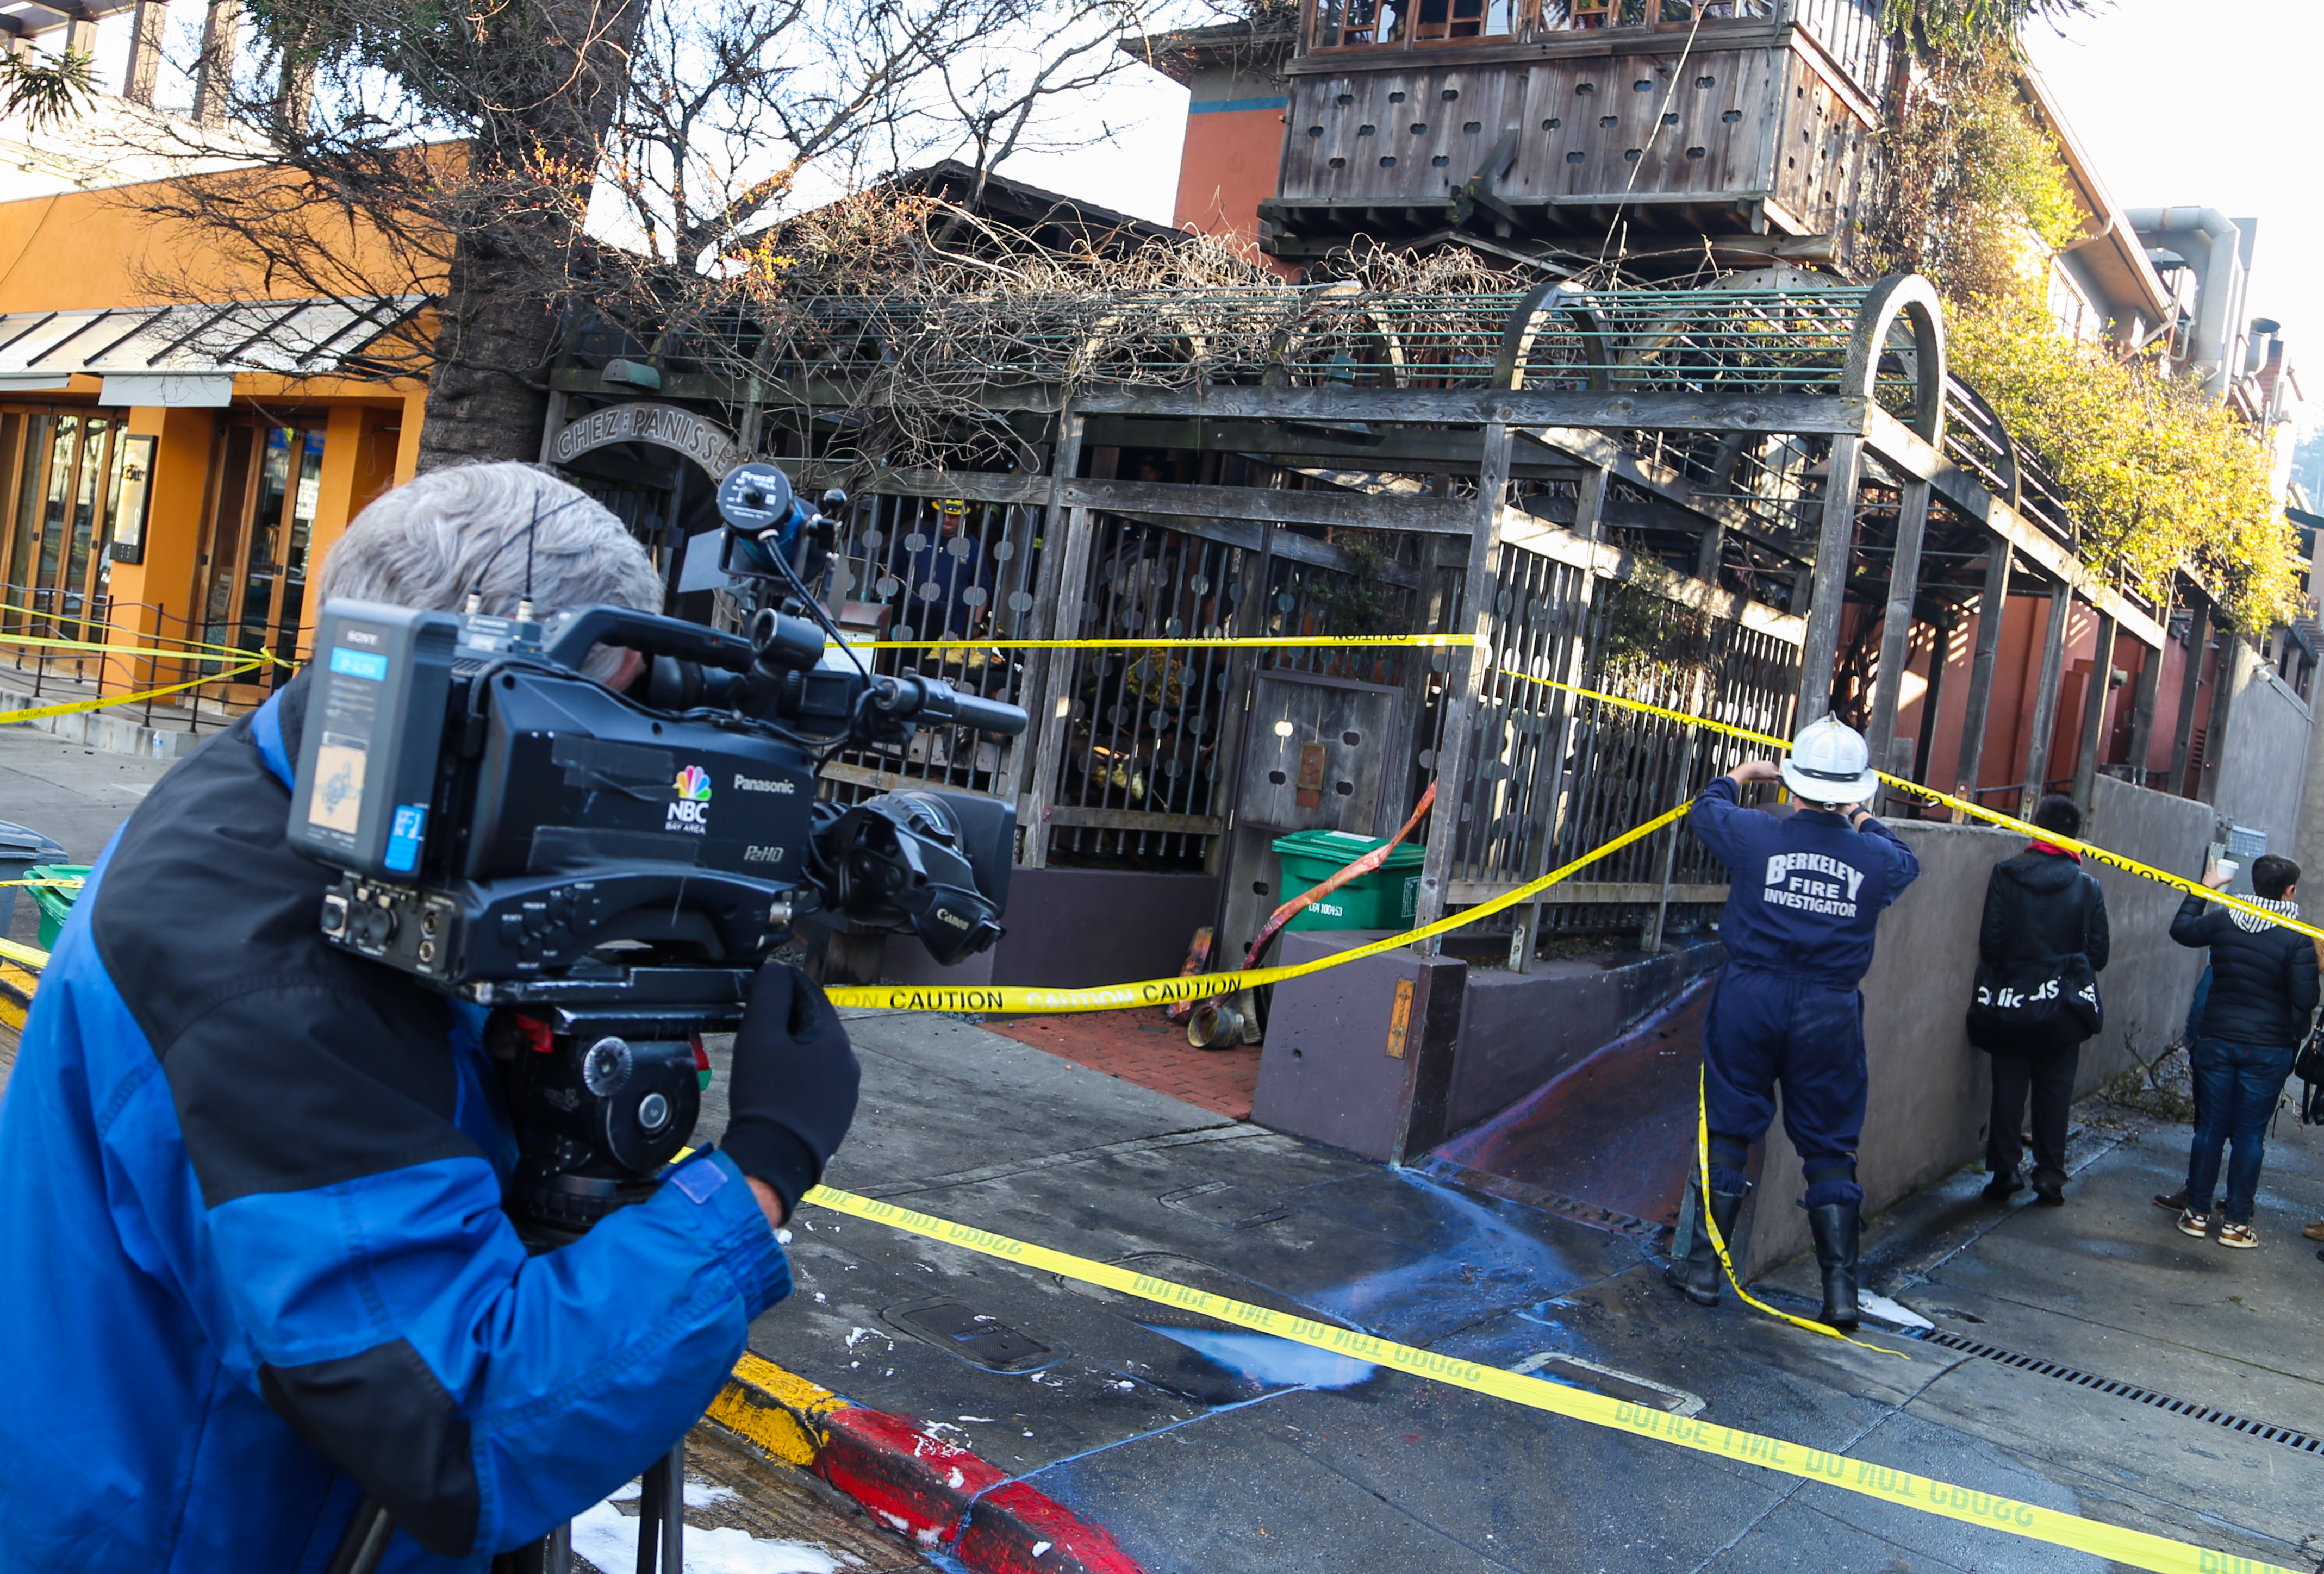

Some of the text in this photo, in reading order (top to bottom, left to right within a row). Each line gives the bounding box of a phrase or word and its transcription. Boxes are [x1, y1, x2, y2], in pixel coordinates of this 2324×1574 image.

[558, 409, 621, 459] CHEZ
[346, 629, 379, 646] SONY
[734, 774, 795, 794] Panasonic
[666, 800, 709, 825] NBC
[665, 821, 706, 835] BAY AREA
[1765, 852, 1865, 902] BERKELEY
[1789, 876, 1840, 898] FIRE
[1764, 888, 1858, 918] INVESTIGATOR
[936, 908, 969, 931] Canon
[889, 989, 1004, 1010] CAUTION
[1026, 988, 1134, 1010] CAUTION
[1142, 973, 1242, 1003] CAUTION
